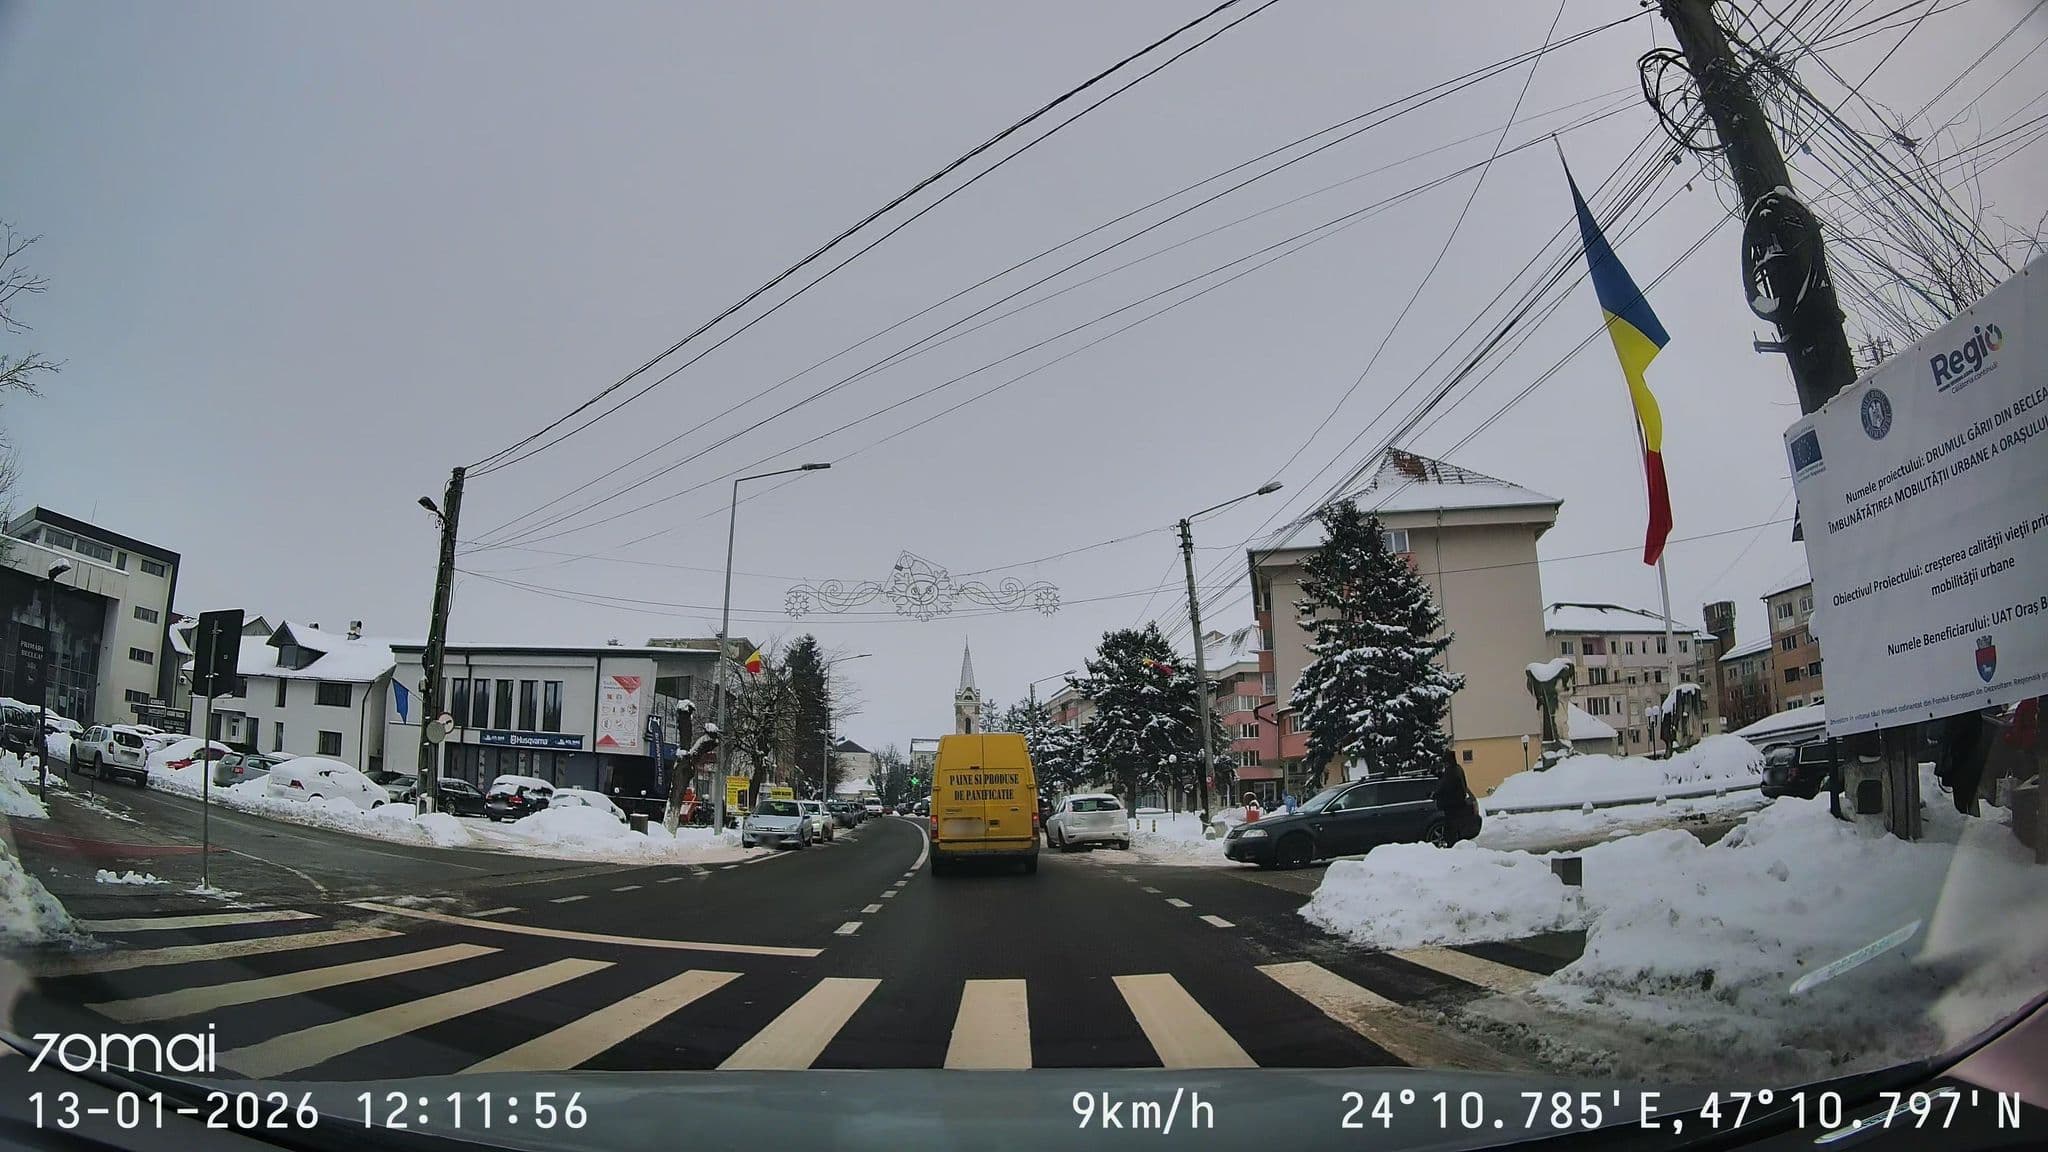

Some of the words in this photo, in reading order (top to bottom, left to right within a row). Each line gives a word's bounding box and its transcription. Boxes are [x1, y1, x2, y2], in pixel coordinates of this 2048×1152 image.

[1929, 322, 2003, 387] Regio
[1845, 482, 1877, 504] Numele
[1878, 457, 1926, 491] proiectului:
[1925, 433, 1967, 464] DRUMUL
[1967, 421, 1994, 442] GĂRII
[1994, 409, 2013, 427] DIN
[1951, 449, 1990, 477] URBANE
[1990, 443, 2000, 457] A
[1980, 556, 2016, 578] urbane
[1833, 581, 1873, 607] Obiectivul
[1873, 564, 1923, 593] Proiectului:
[1887, 633, 1922, 656] Numele
[1923, 615, 1990, 646] Beneficiarului:
[1991, 607, 2013, 626] UAT
[516, 735, 548, 746] Husqvarna
[950, 774, 972, 785] PAINE
[984, 773, 1019, 785] PRODUSE
[954, 790, 964, 801] DE
[966, 788, 1014, 801] PANIFICATIE
